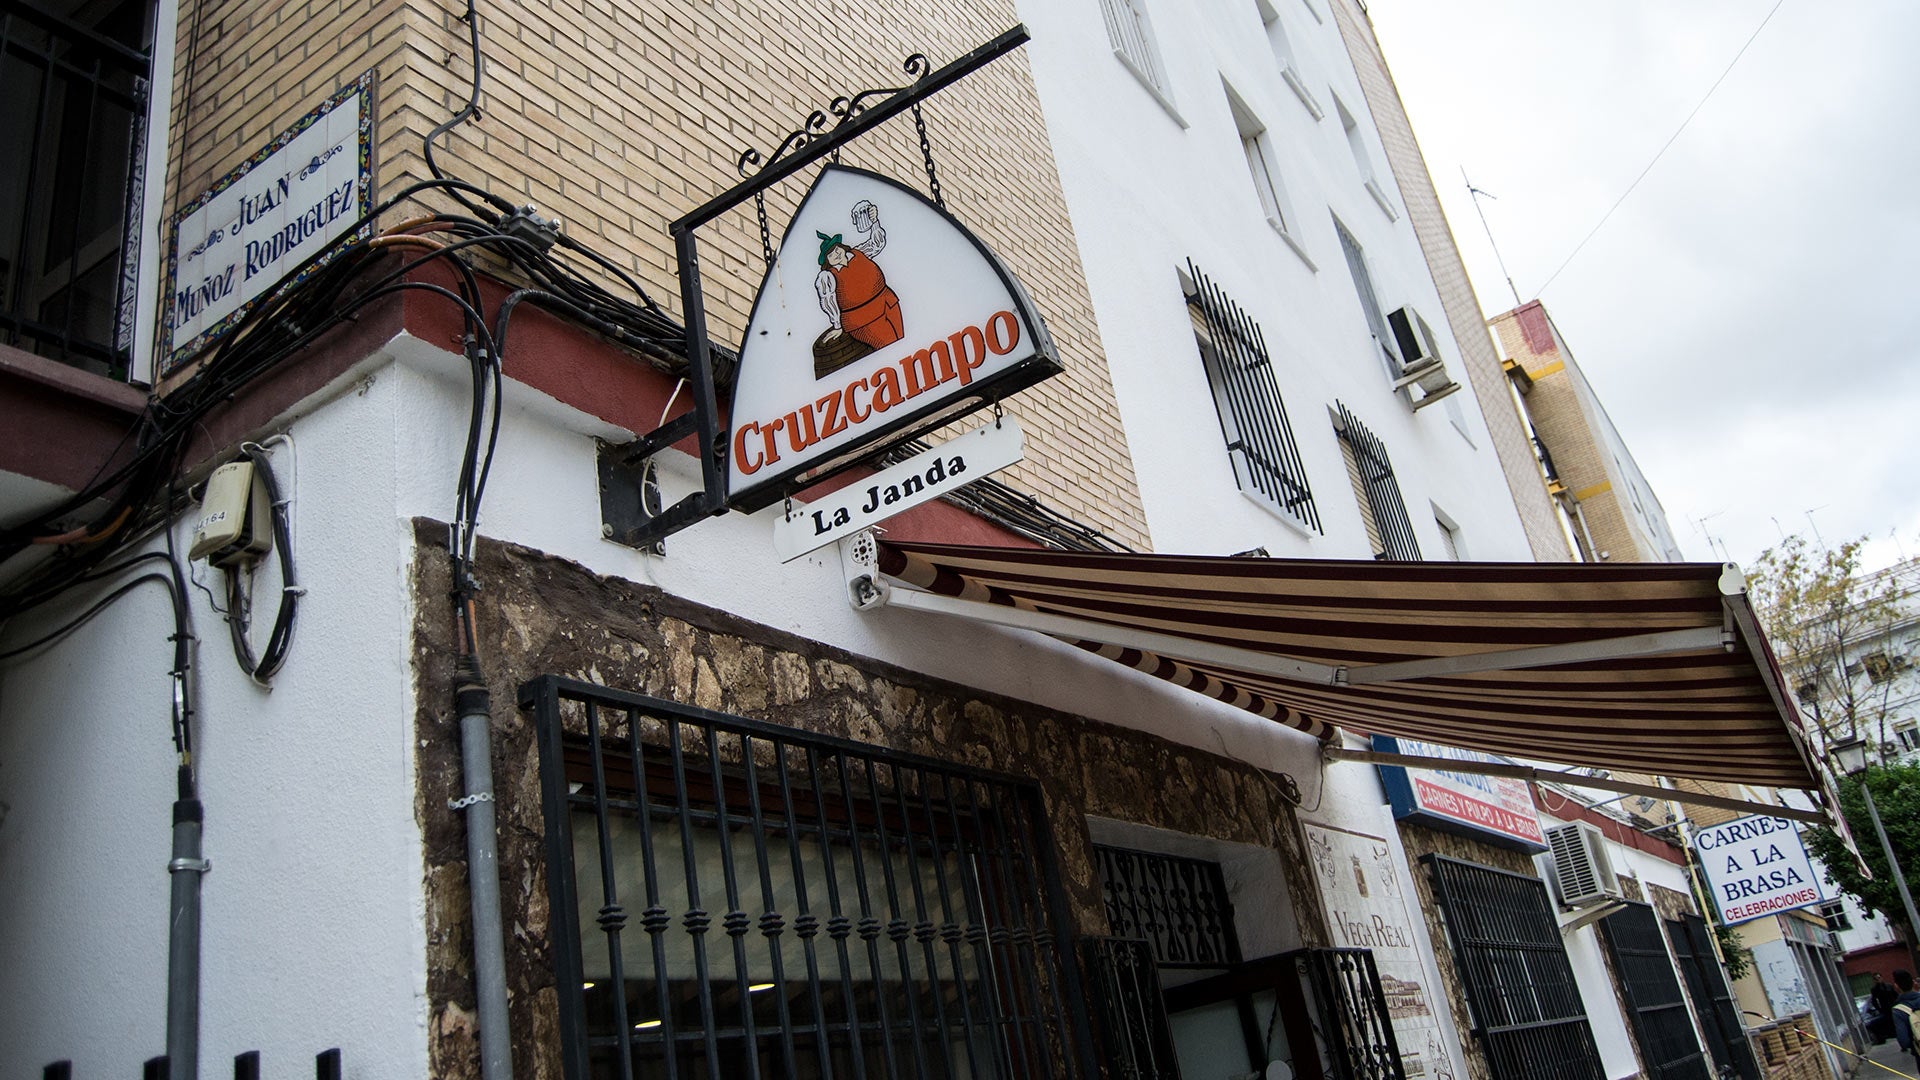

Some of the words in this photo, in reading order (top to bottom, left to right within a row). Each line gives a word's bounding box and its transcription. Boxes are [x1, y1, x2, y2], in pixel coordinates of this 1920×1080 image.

[231, 172, 291, 236] JUAN
[175, 264, 236, 331] MUÑOZ
[733, 310, 1021, 476] Cruzcampo
[811, 506, 851, 536] La
[861, 455, 967, 514] Janda
[1418, 783, 1459, 813] CARNES
[1455, 796, 1466, 816] Y
[1465, 800, 1494, 824] PULPO
[1495, 810, 1504, 827] A
[1503, 814, 1516, 831] LA
[1516, 817, 1541, 839] BRASA
[1698, 816, 1789, 850] CARNES
[1722, 867, 1804, 902] BRASA
[1726, 855, 1743, 874] A
[1751, 844, 1786, 866] LA
[1725, 888, 1816, 921] CELEBRACIONES
